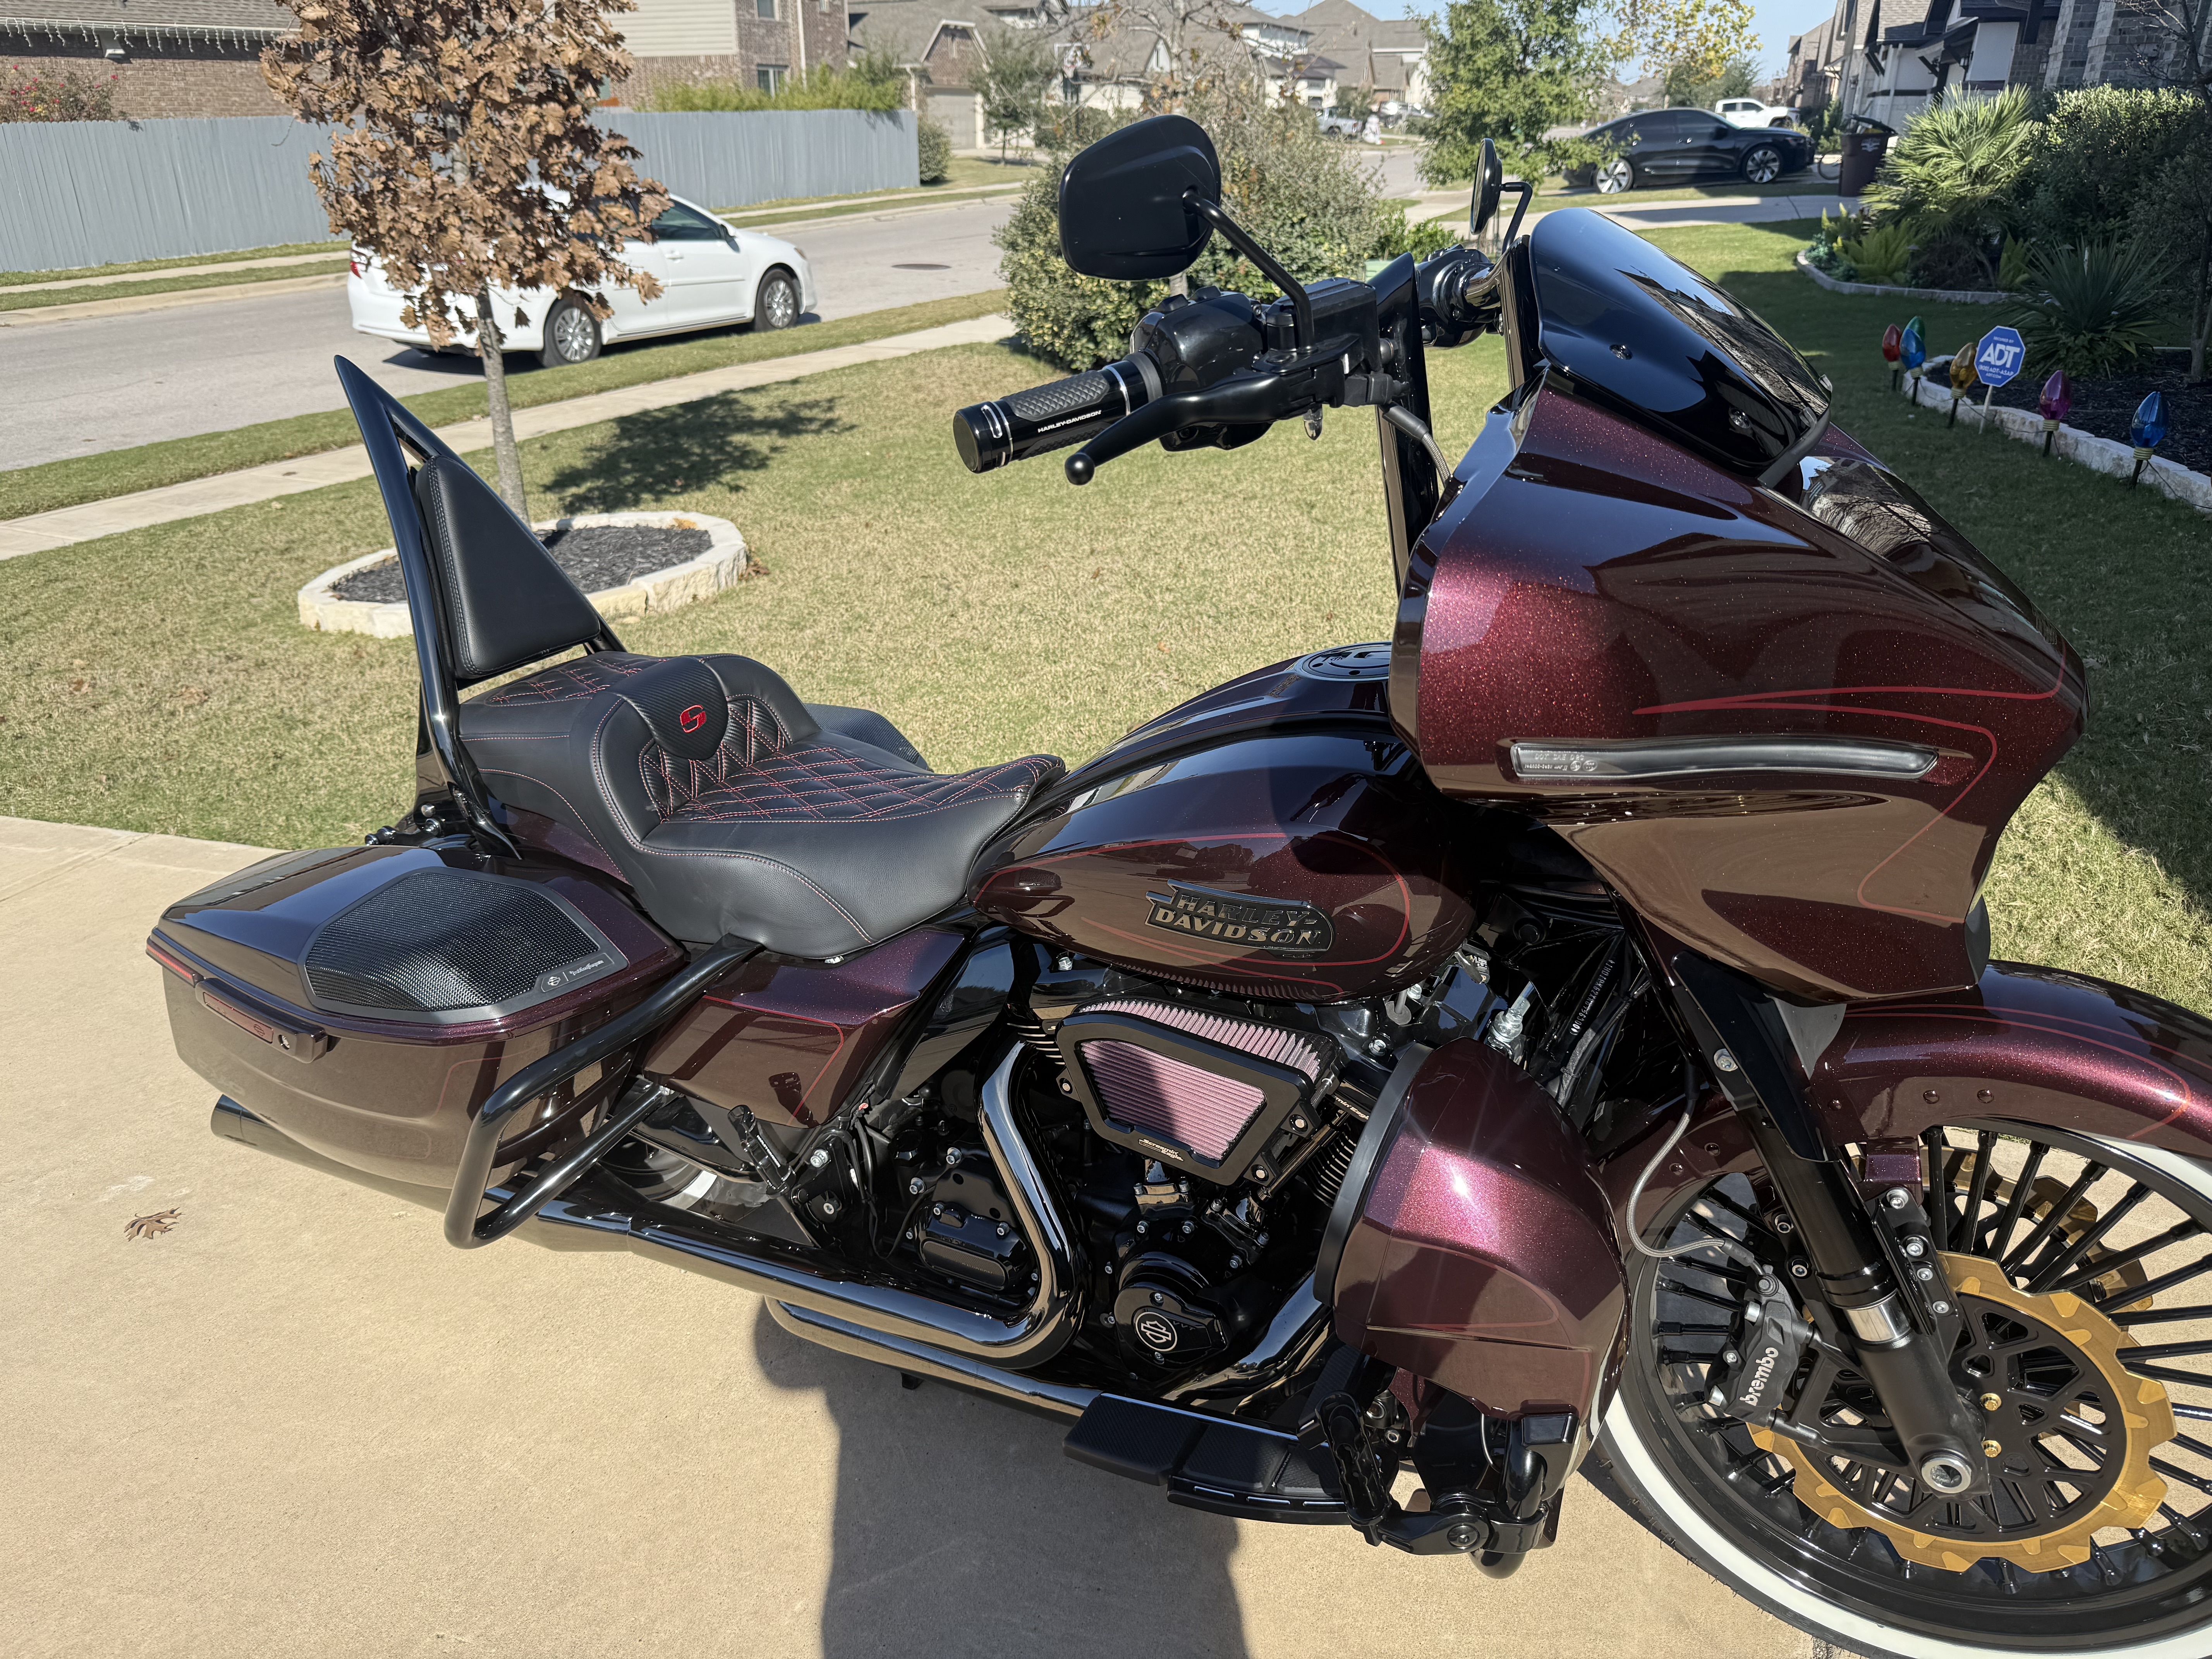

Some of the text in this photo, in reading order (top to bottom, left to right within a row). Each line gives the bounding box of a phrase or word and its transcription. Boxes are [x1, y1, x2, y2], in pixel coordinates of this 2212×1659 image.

[1979, 342, 2021, 368] ADT
[1038, 410, 1101, 433] HARLEY-DAVIDSON
[1155, 907, 1321, 945] DAVIDSON
[1739, 1347, 1779, 1406] brembo
